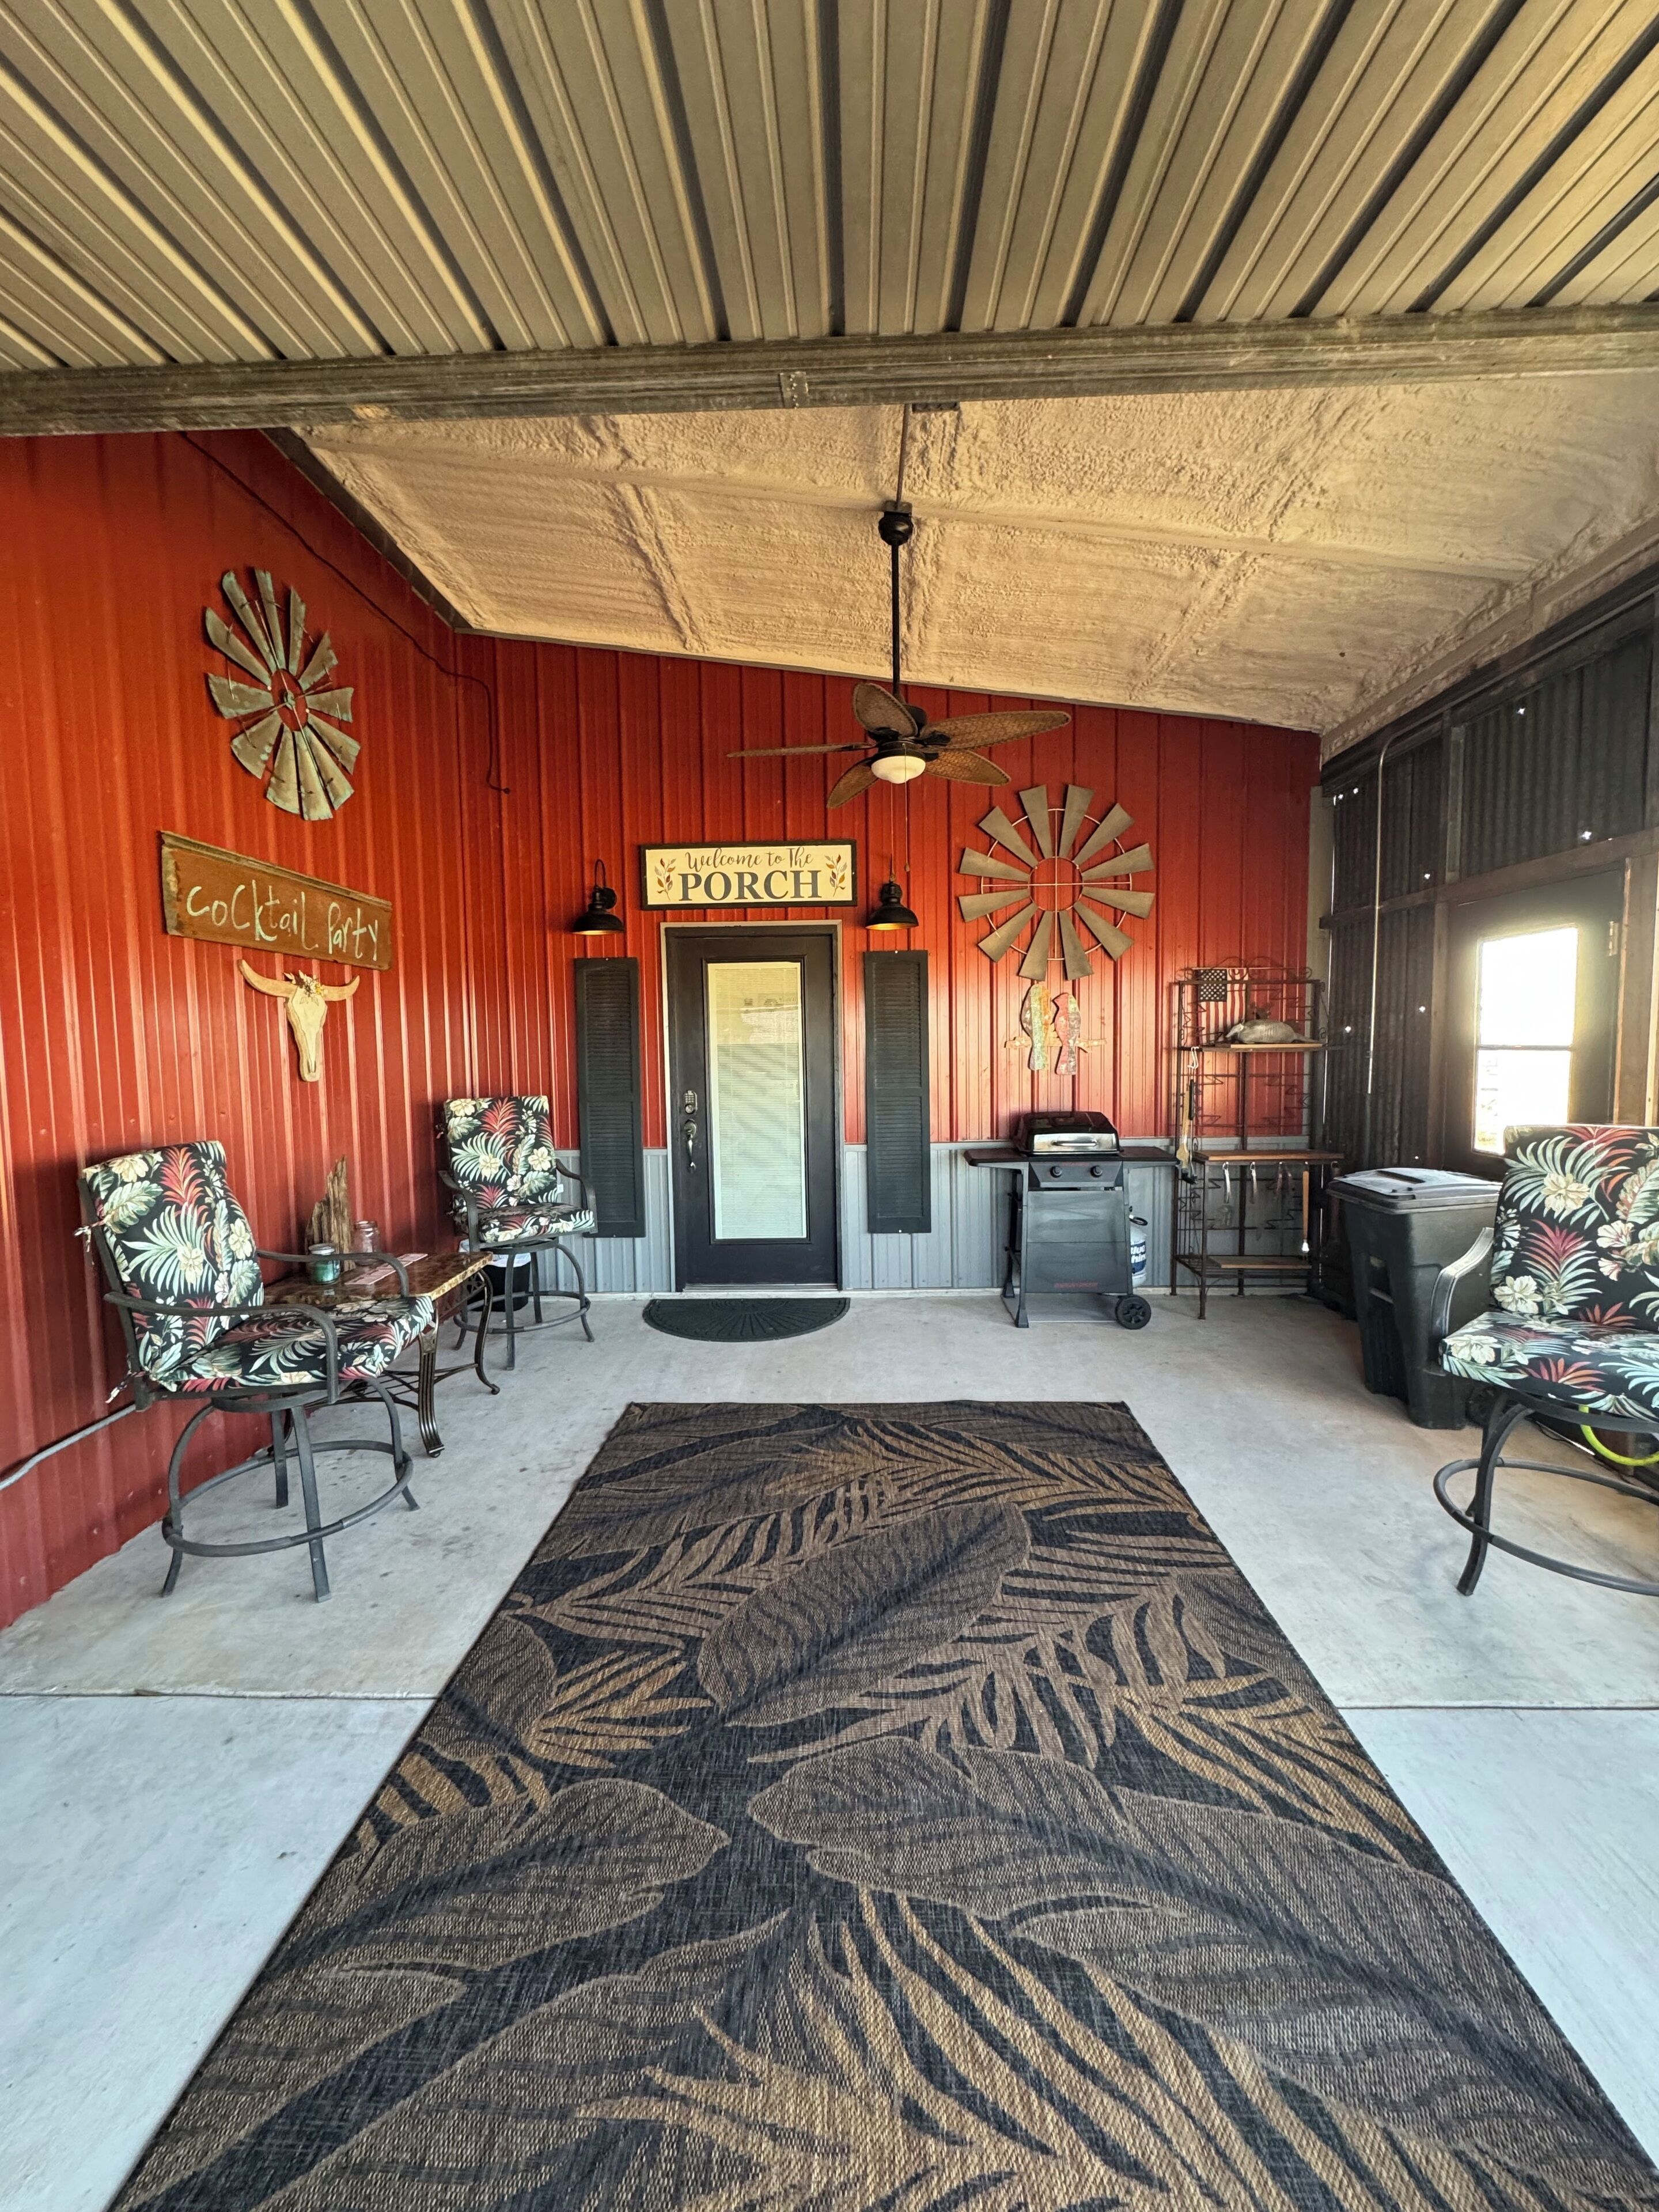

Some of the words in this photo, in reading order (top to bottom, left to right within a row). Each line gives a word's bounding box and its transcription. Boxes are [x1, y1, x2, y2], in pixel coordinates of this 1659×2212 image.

[684, 848, 762, 873] Welcome
[766, 851, 785, 865] to
[787, 846, 814, 869] The
[678, 869, 822, 902] PORCH
[328, 902, 378, 961] Party
